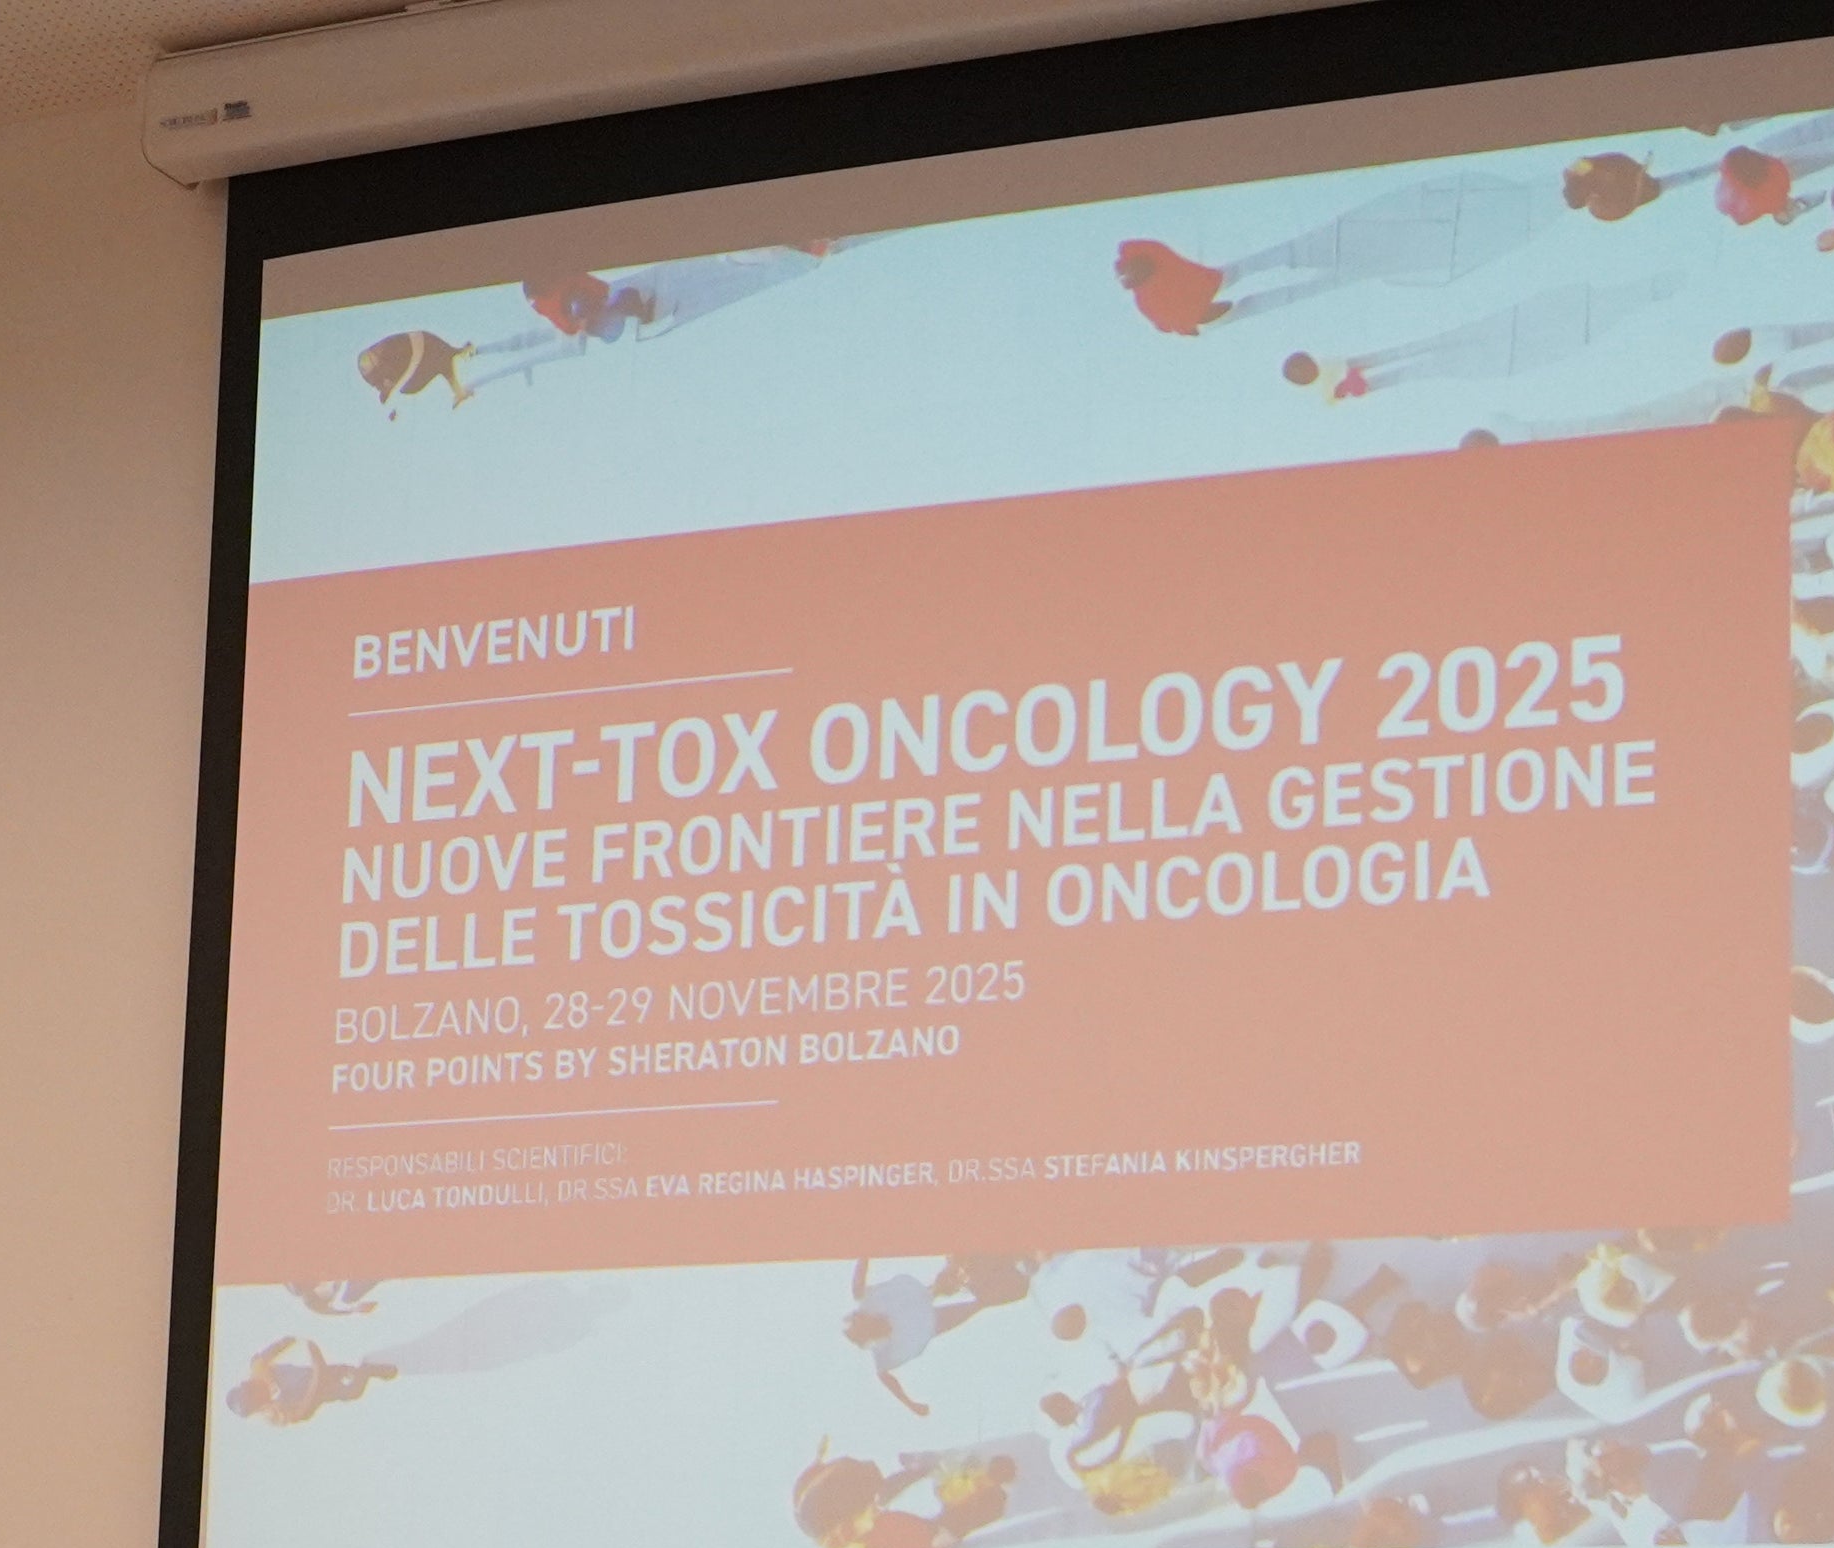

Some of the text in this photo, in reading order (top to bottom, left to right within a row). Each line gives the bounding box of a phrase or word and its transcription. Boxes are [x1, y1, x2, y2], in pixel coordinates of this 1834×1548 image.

[354, 605, 637, 681] BENVENUTI
[349, 634, 1627, 828] NEXT-TOX ONCOLOGY 2025
[343, 739, 1659, 905] NUOVE FRONTIERE NELLA GESTIONE
[340, 838, 1493, 980] DELLE TOSSICITÀ IN ONCOLOGIA
[336, 961, 1027, 1045] BOLZANO, 28-29 NOVEMBRE 2025
[333, 1025, 962, 1093] FOUR POINTS BY SHERATON BOLZANO
[327, 1151, 484, 1179] RESPONSABILI
[367, 1188, 425, 1212] LUCA
[433, 1181, 548, 1208] TONDULLI,
[646, 1174, 691, 1197] EVA
[698, 1170, 786, 1195] REGINA
[793, 1161, 937, 1190] HASPINGER,
[948, 1157, 1035, 1183] DR.SSA
[1044, 1151, 1167, 1179] STEFANIA
[1175, 1141, 1360, 1172] KINSPERGHER
